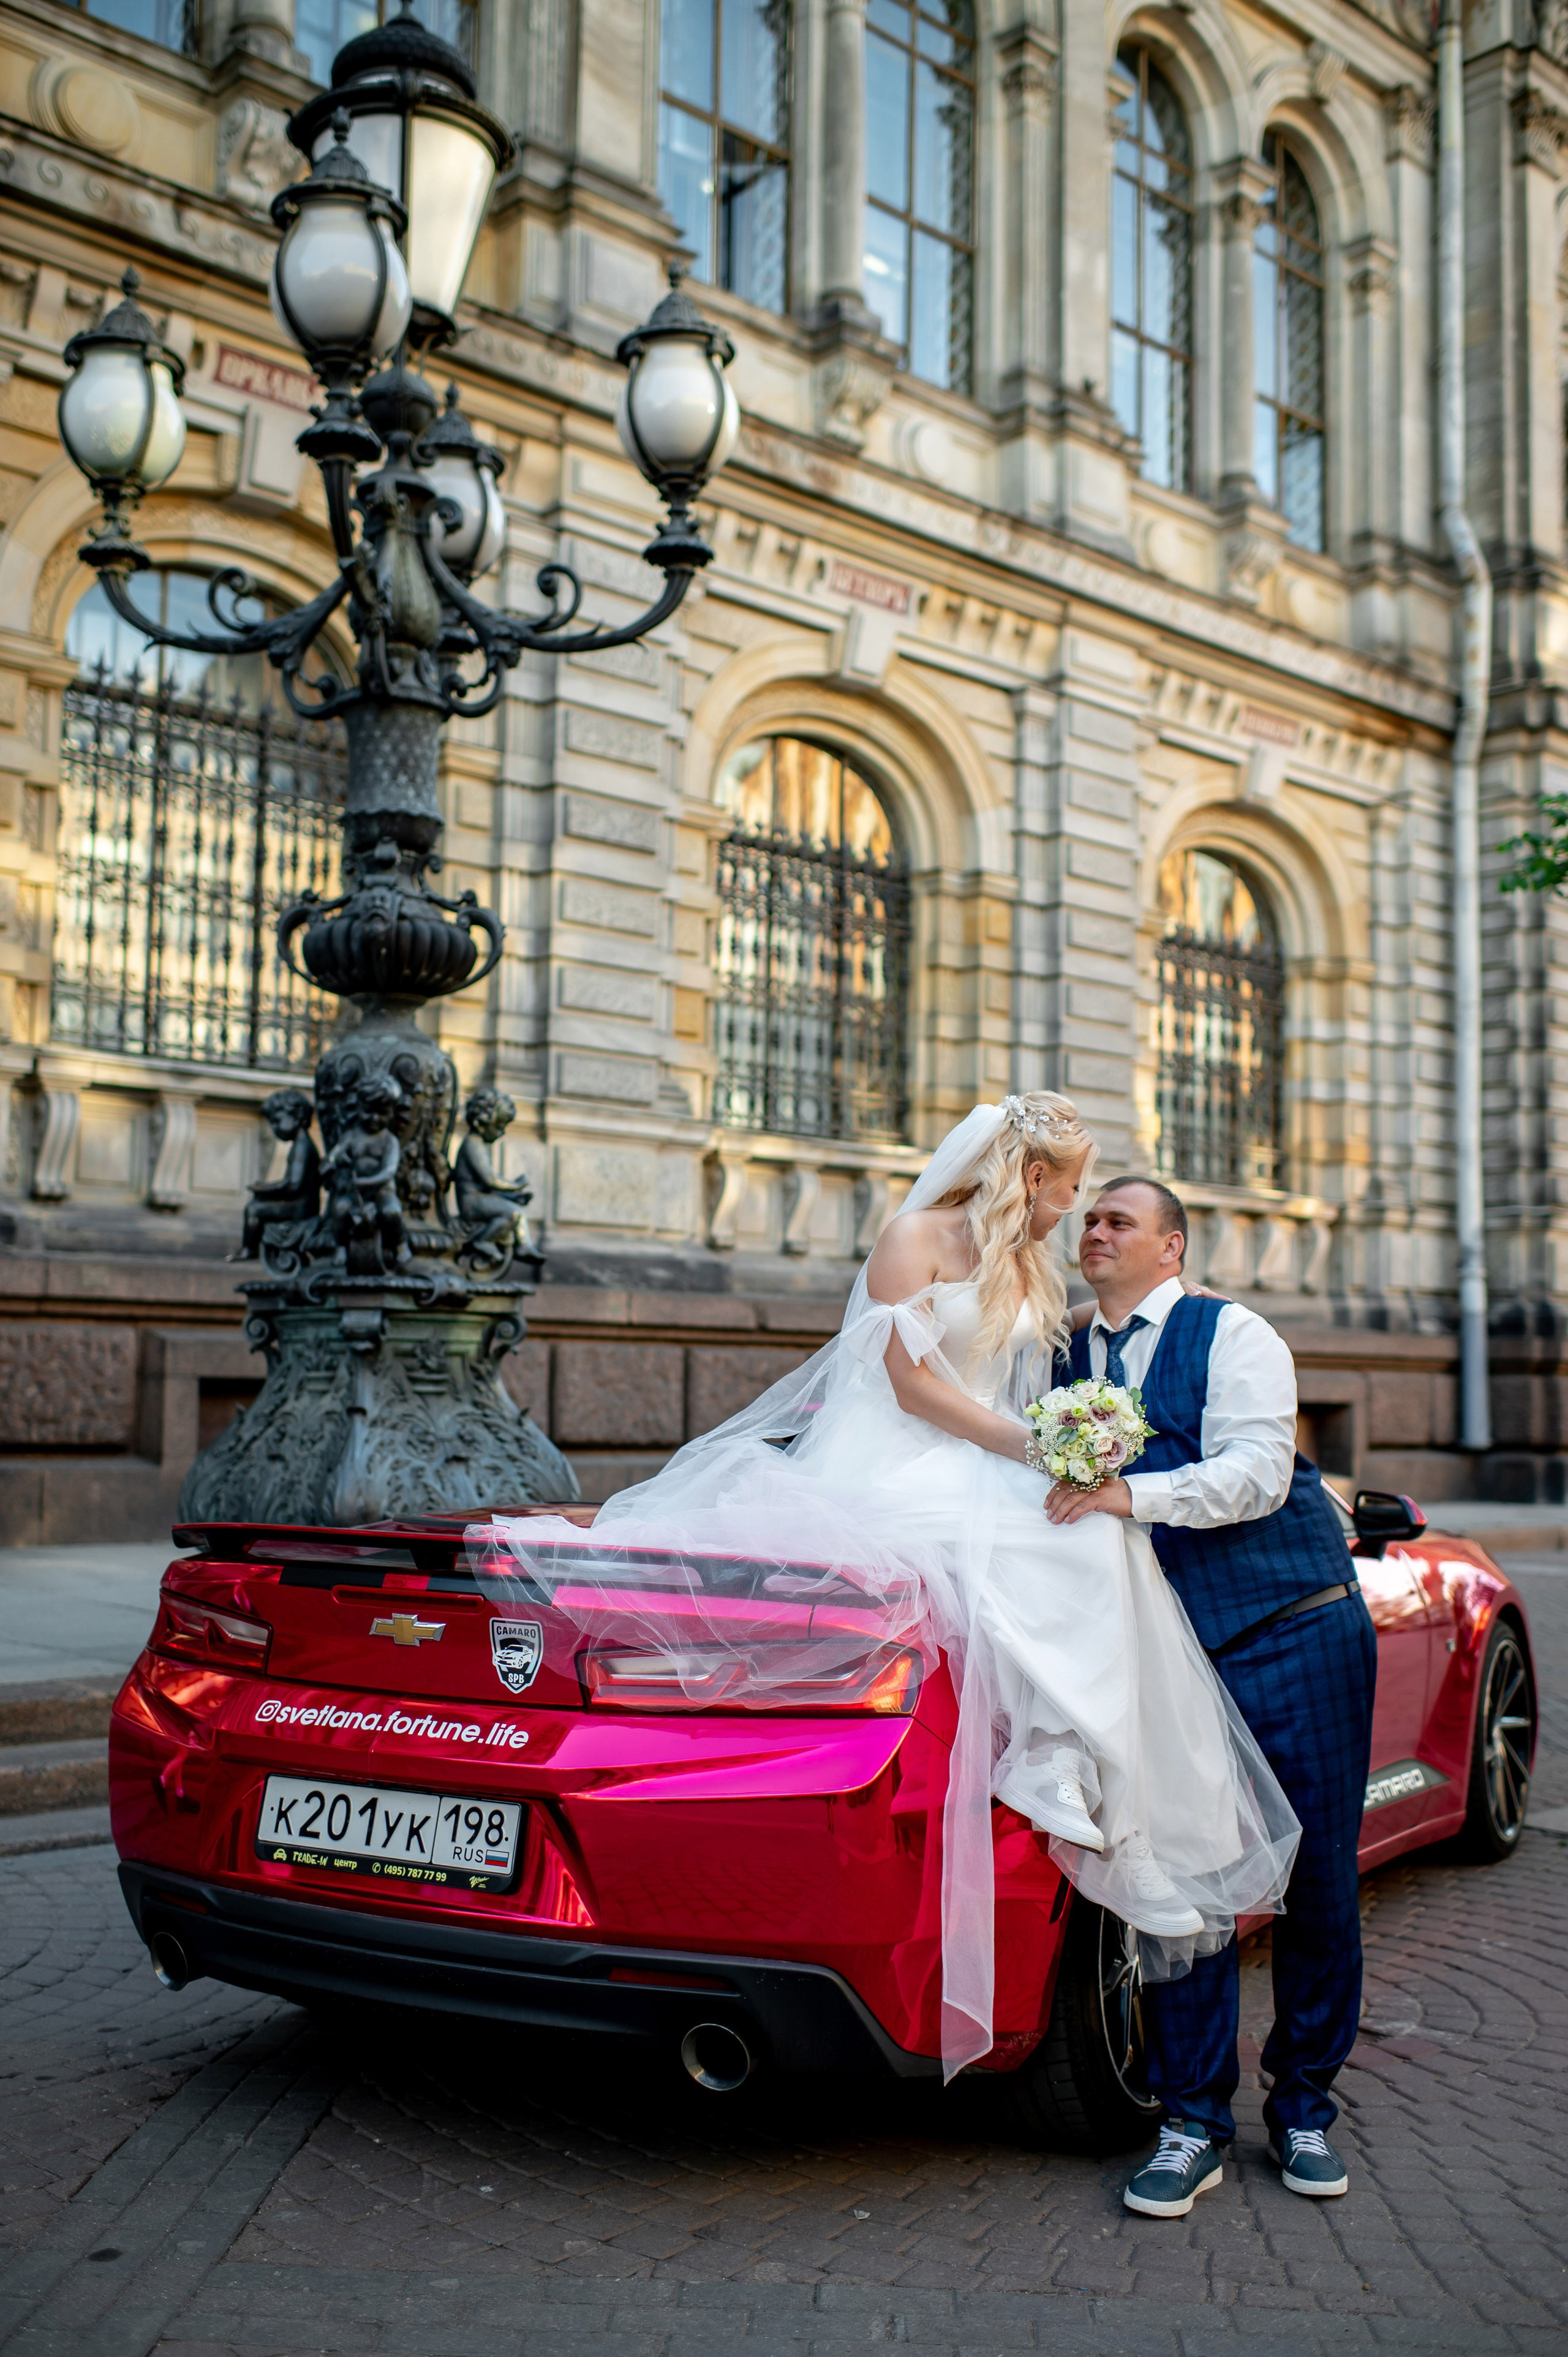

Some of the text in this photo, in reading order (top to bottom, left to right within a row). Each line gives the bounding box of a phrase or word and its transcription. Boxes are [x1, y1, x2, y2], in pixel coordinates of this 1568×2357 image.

[497, 1626, 537, 1639] CAMARO
[508, 1673, 525, 1684] SPB
[276, 1705, 529, 1749] svetlana.fortune.life
[444, 1803, 505, 1847] 198
[293, 1851, 357, 1870] TRADE-IN центр
[453, 1846, 484, 1863] RUS
[384, 1865, 447, 1882] (495) 787 77 99
